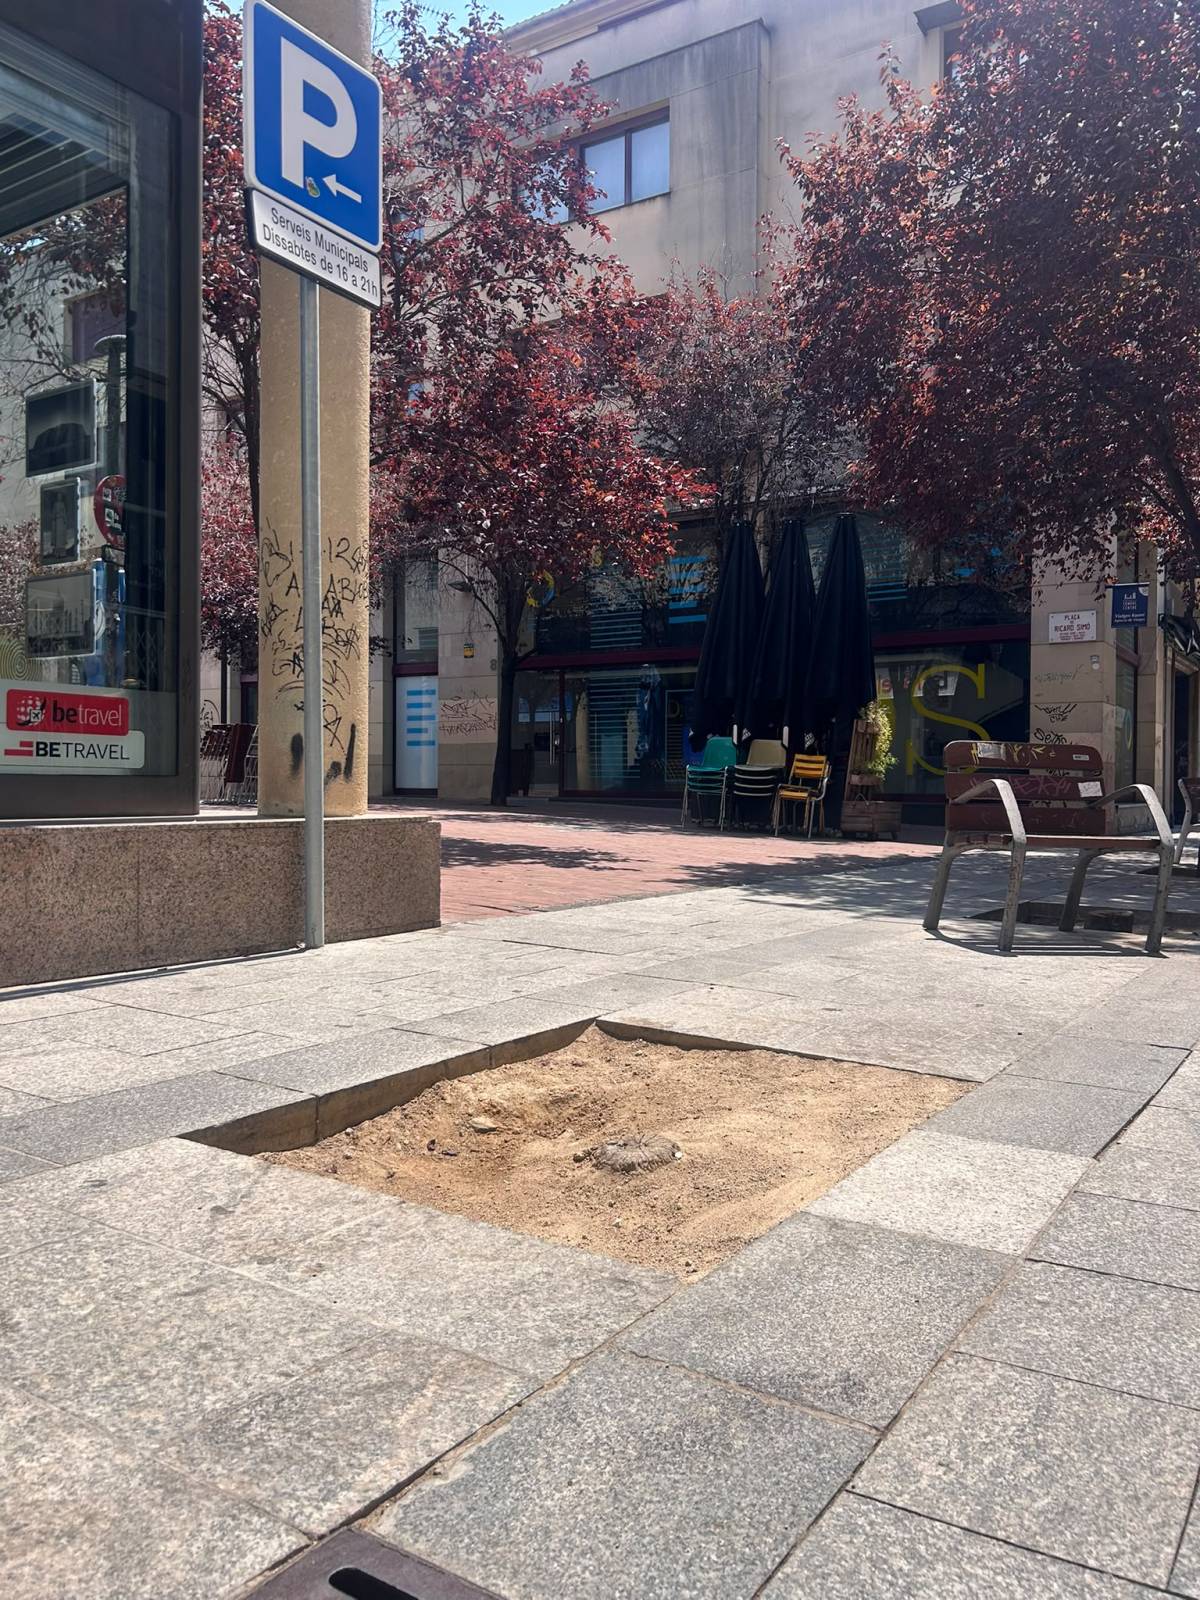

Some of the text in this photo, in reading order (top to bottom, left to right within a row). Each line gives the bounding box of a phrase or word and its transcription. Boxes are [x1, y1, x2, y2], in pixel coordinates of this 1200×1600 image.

[281, 37, 358, 189] P
[263, 223, 316, 265] Dissabtes
[320, 256, 333, 274] de
[336, 264, 348, 282] 16
[351, 276, 358, 288] a
[271, 207, 368, 272] Serveis Municipals
[490, 658, 498, 671] 8
[52, 699, 122, 727] betravel
[35, 740, 130, 761] BETRAVEL
